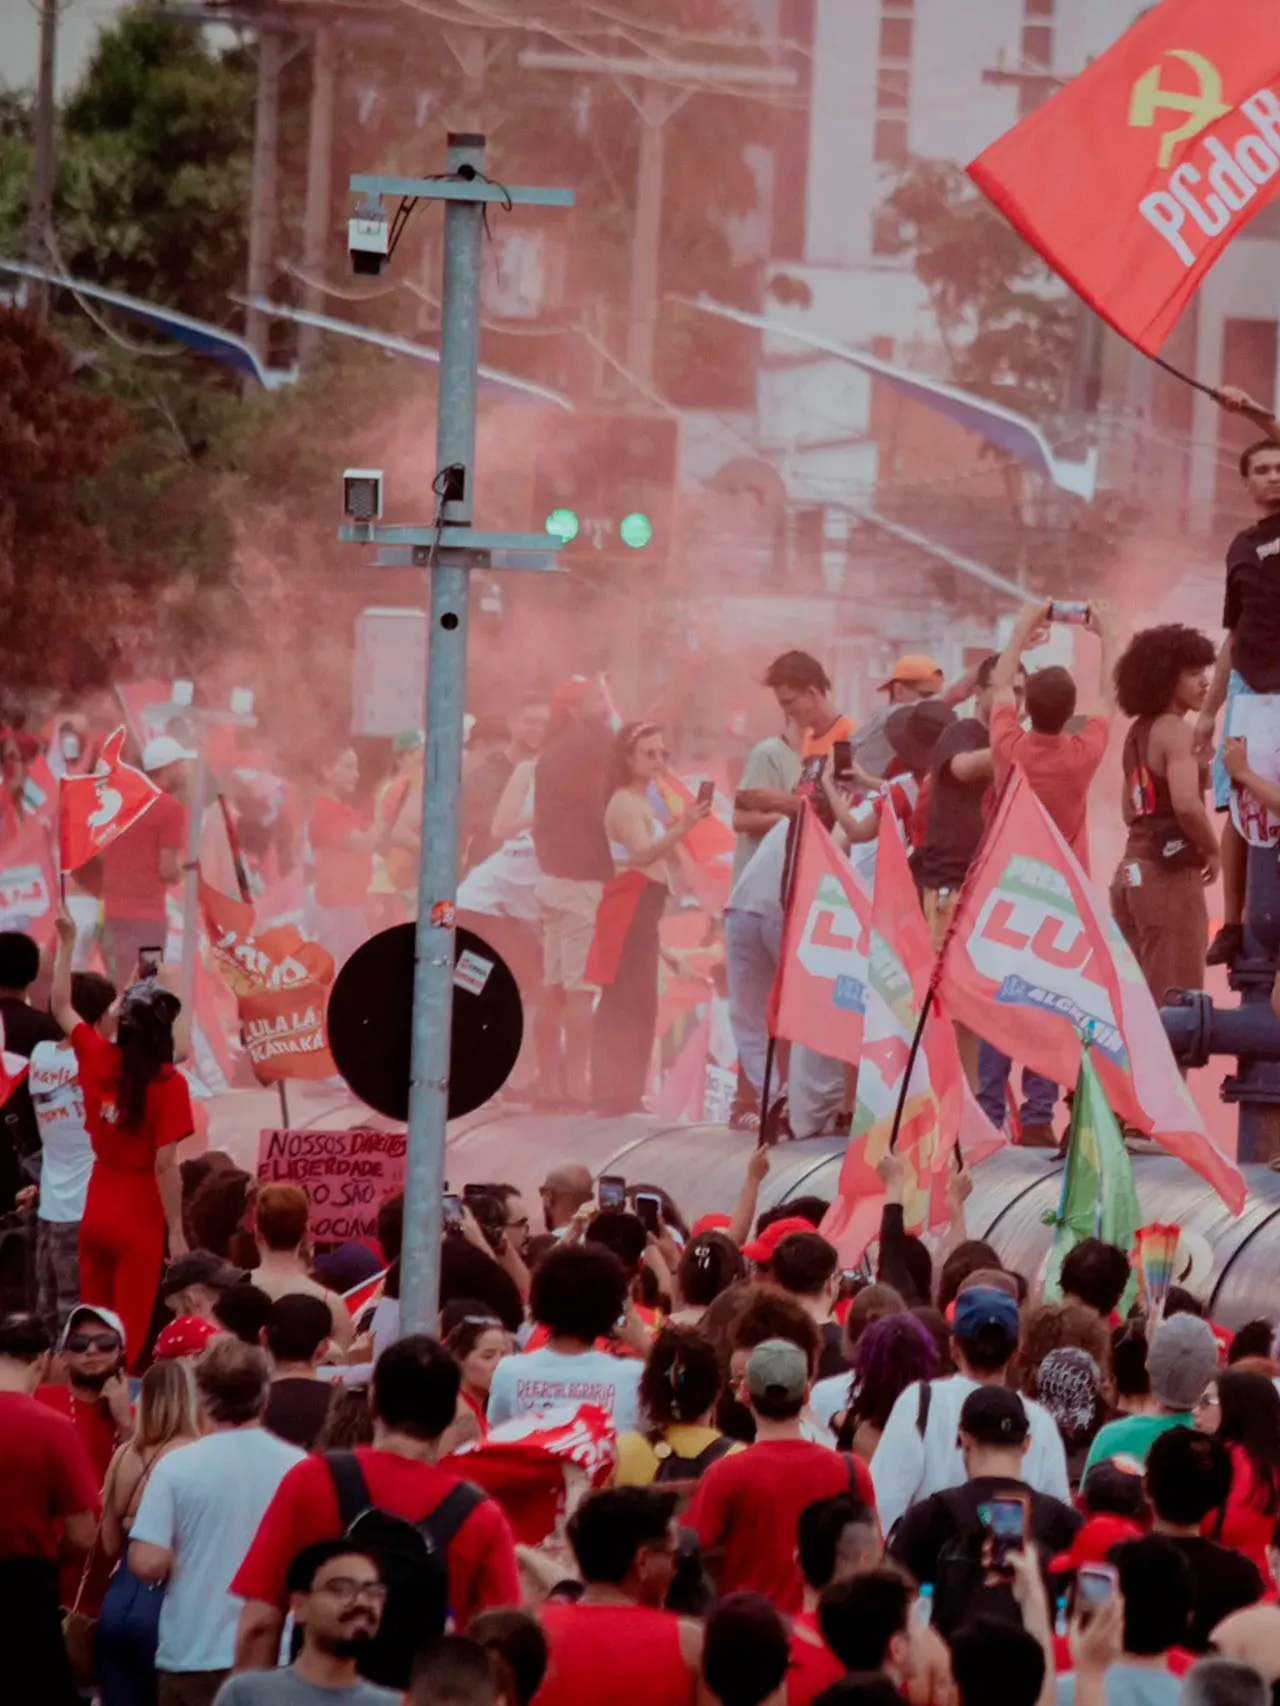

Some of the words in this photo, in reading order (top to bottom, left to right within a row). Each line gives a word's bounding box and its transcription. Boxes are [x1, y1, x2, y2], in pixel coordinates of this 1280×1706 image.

[267, 1131, 346, 1160] NOSSOS
[272, 1156, 384, 1182] LIBERDADE
[330, 1178, 375, 1207] SÃO
